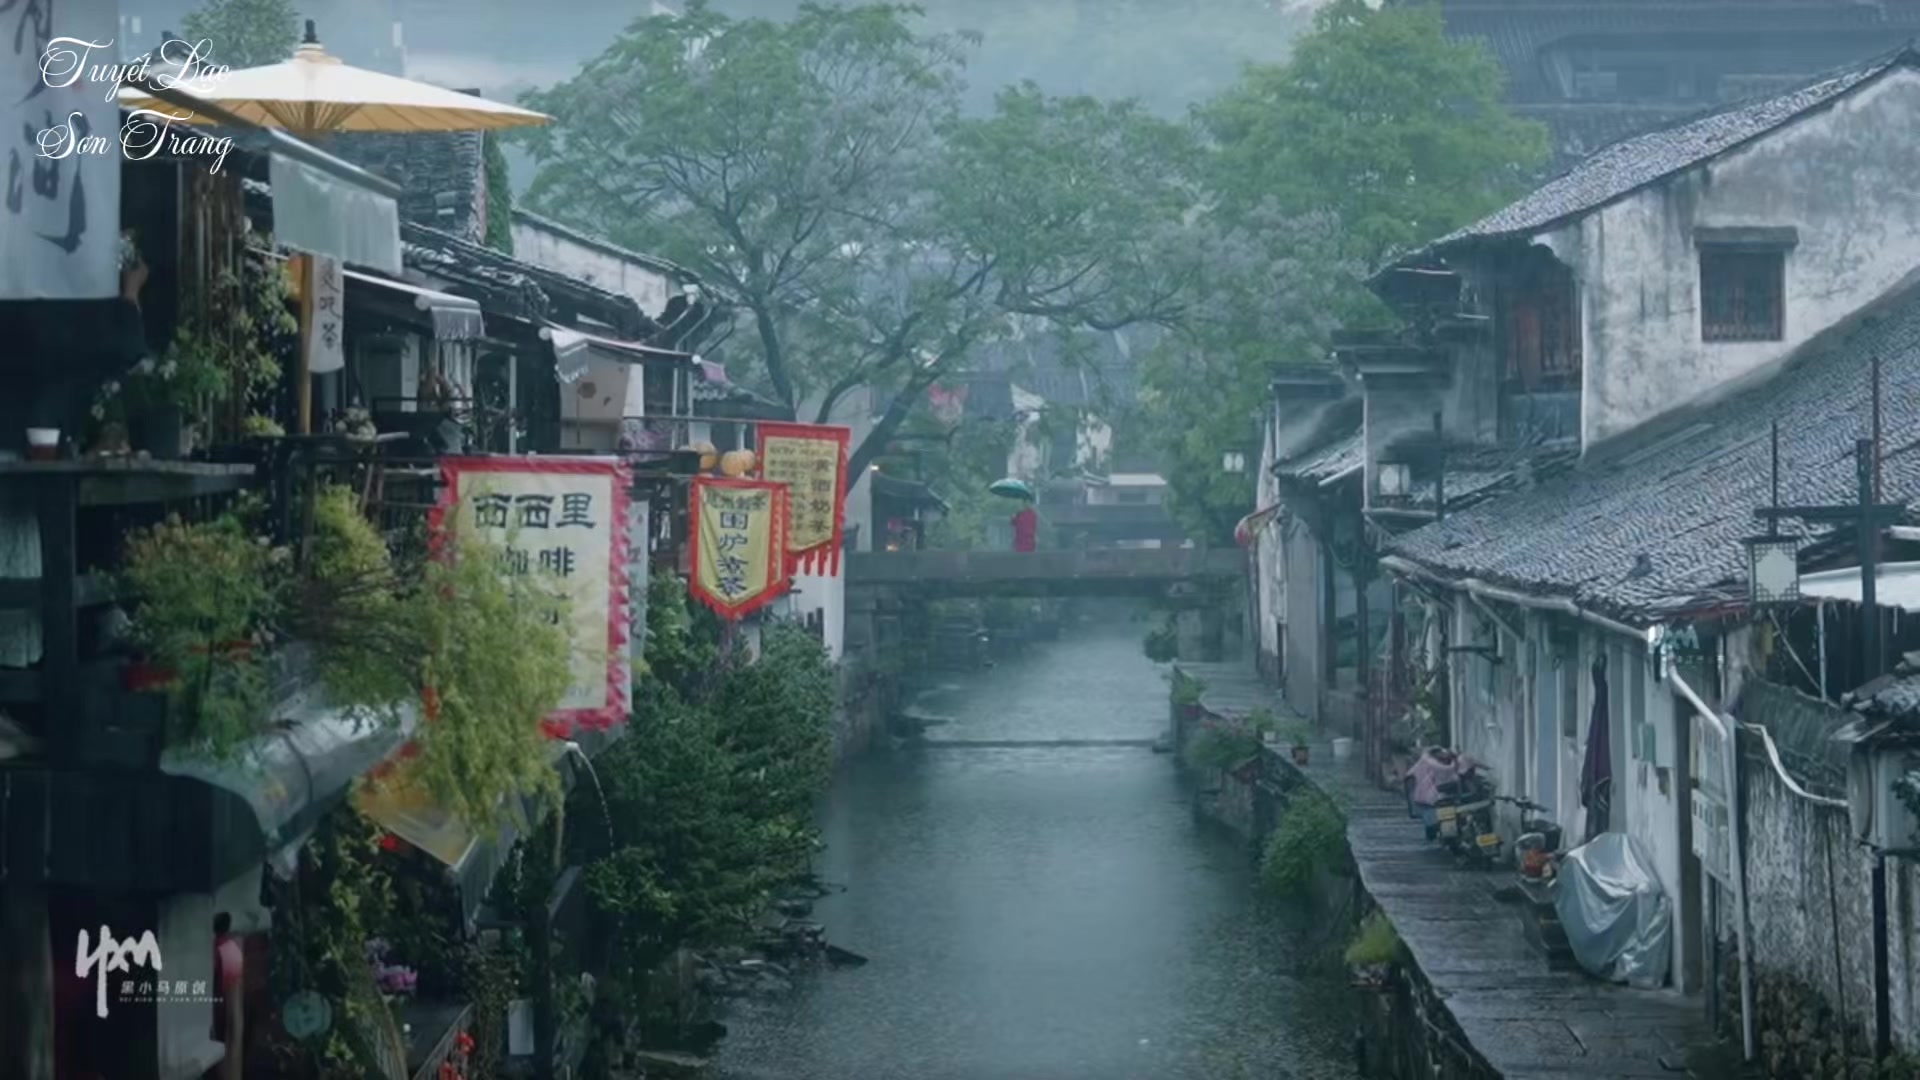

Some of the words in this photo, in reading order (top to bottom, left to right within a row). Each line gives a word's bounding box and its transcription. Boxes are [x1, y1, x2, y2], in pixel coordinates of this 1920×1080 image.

[472, 492, 596, 529] 西西里
[717, 511, 748, 597] 围炉煮茶
